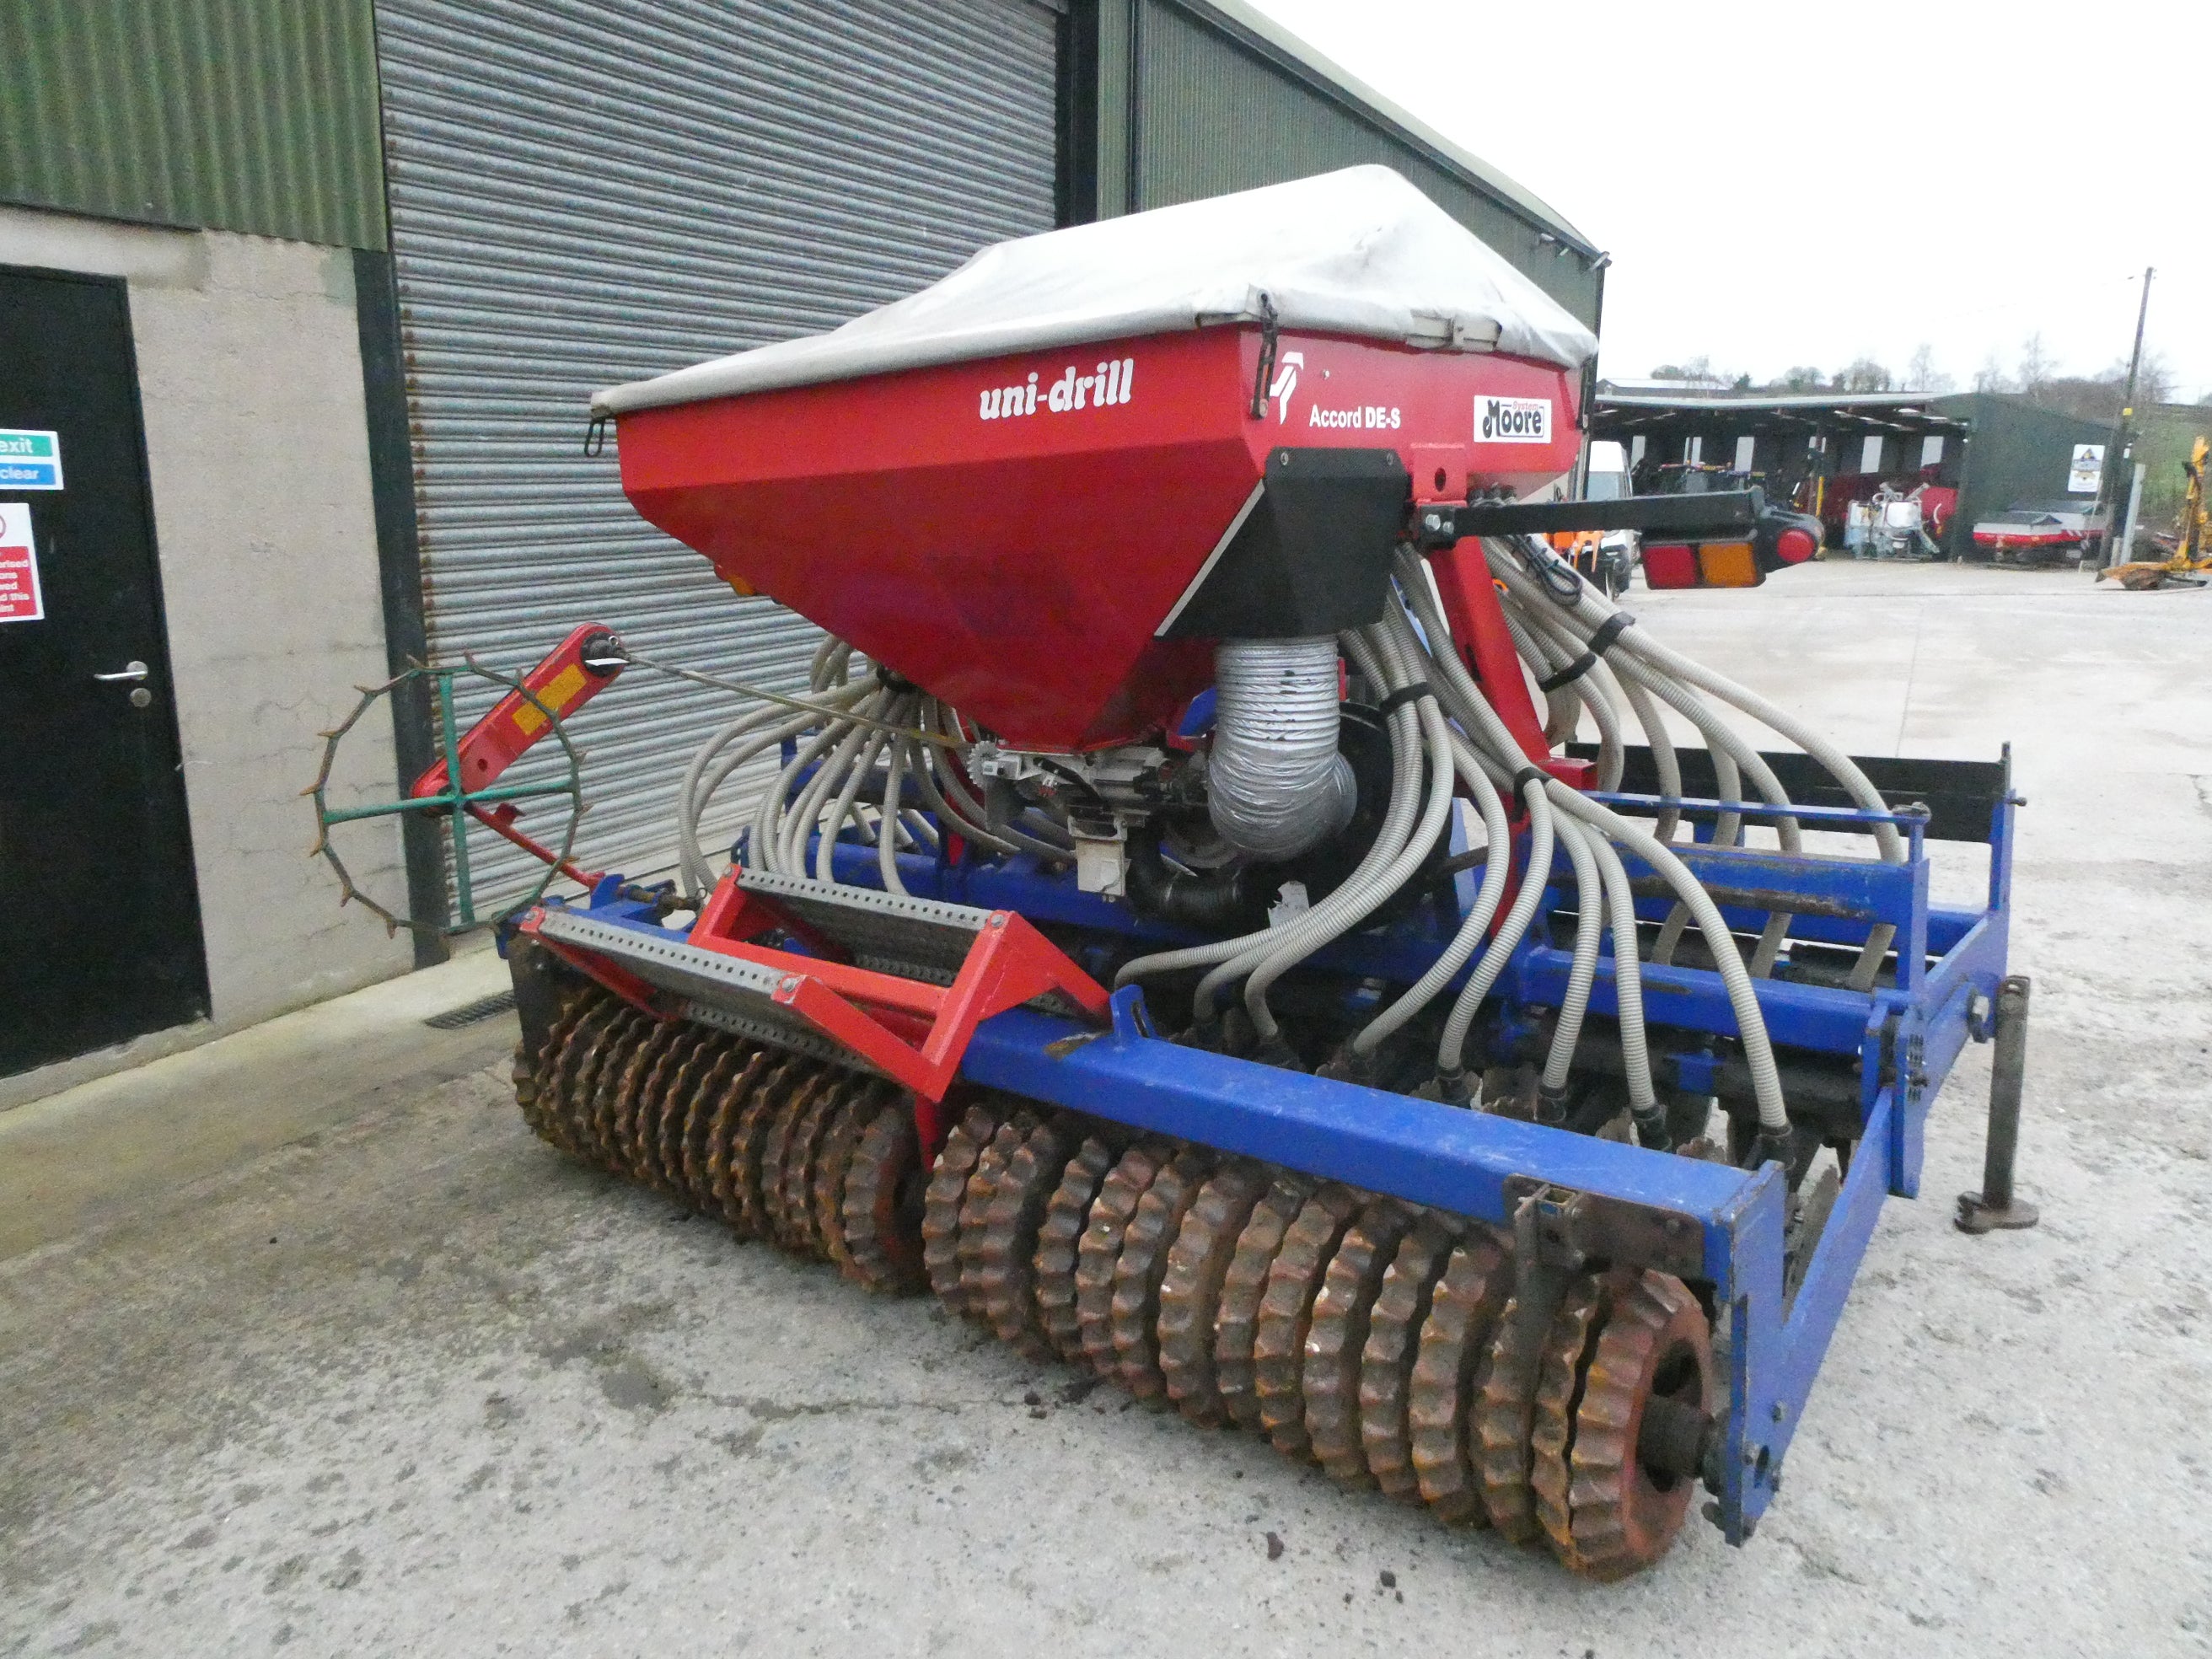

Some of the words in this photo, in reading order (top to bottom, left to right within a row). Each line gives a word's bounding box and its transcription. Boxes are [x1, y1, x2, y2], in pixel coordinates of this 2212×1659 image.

[980, 357, 1134, 420] uni-drill
[1512, 400, 1538, 411] System
[1309, 404, 1361, 428] Accord
[1365, 406, 1401, 429] DE-S
[1482, 399, 1542, 438] Moore
[0, 438, 34, 454] exit
[0, 465, 39, 480] clear
